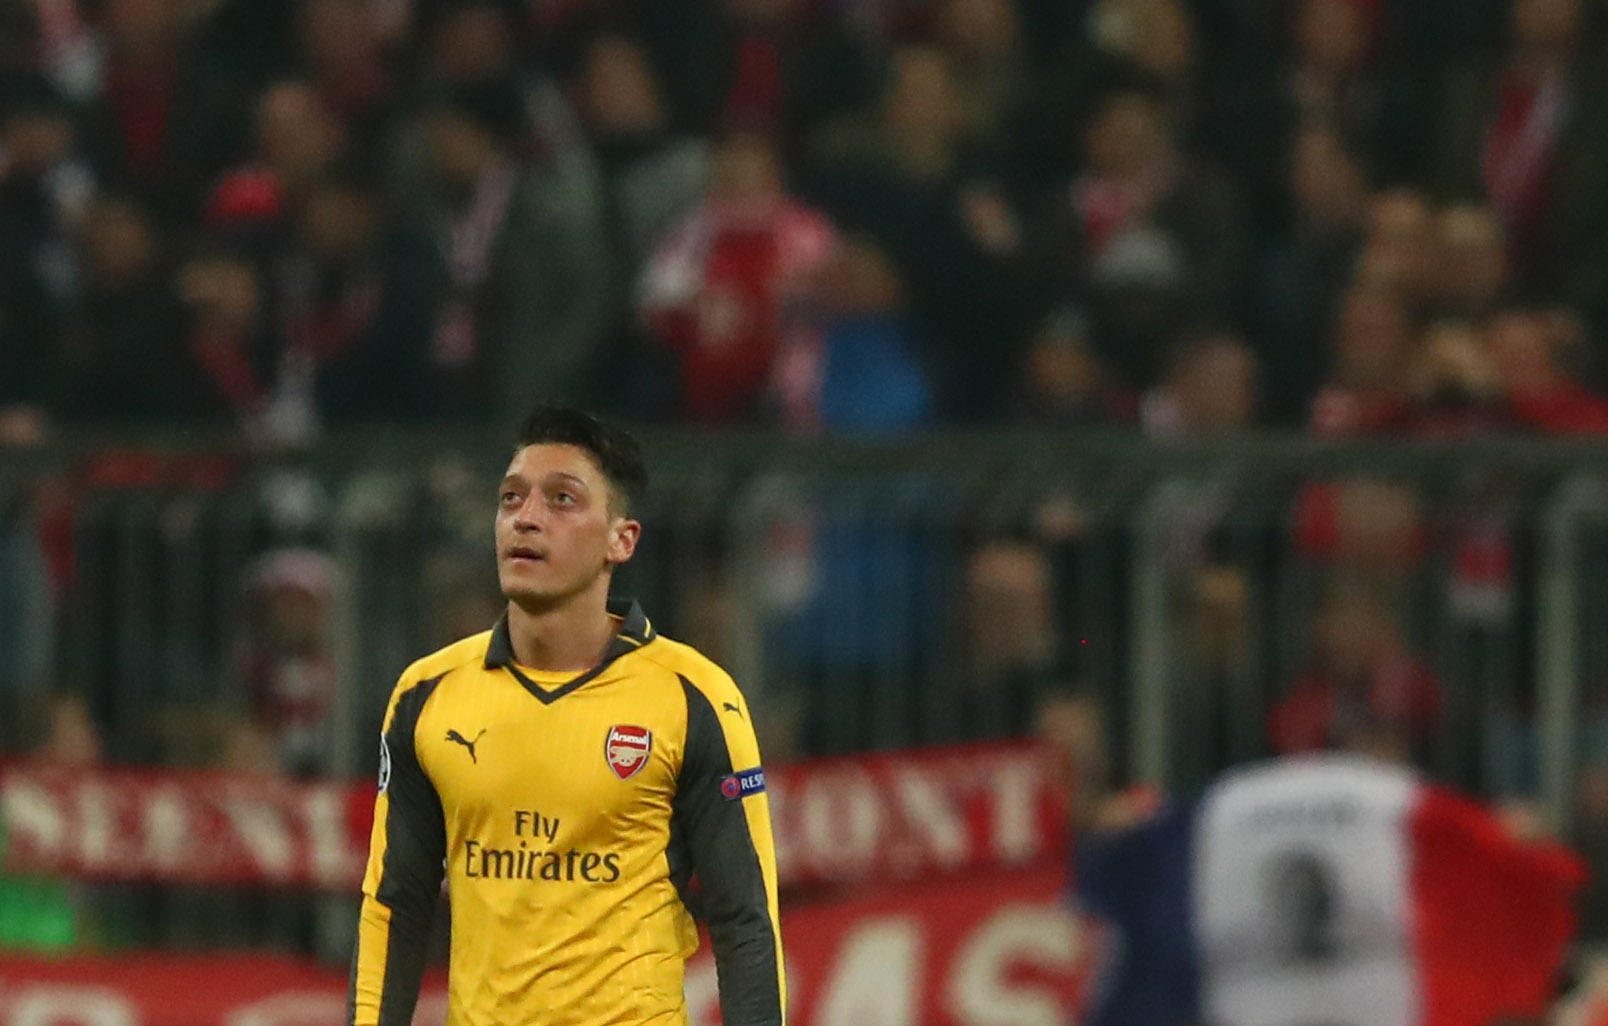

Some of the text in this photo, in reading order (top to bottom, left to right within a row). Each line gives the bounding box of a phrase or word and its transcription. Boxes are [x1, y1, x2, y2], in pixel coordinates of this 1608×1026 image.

[611, 731, 647, 745] Arsenal
[515, 810, 560, 844] Fly
[465, 840, 621, 883] Emirates
